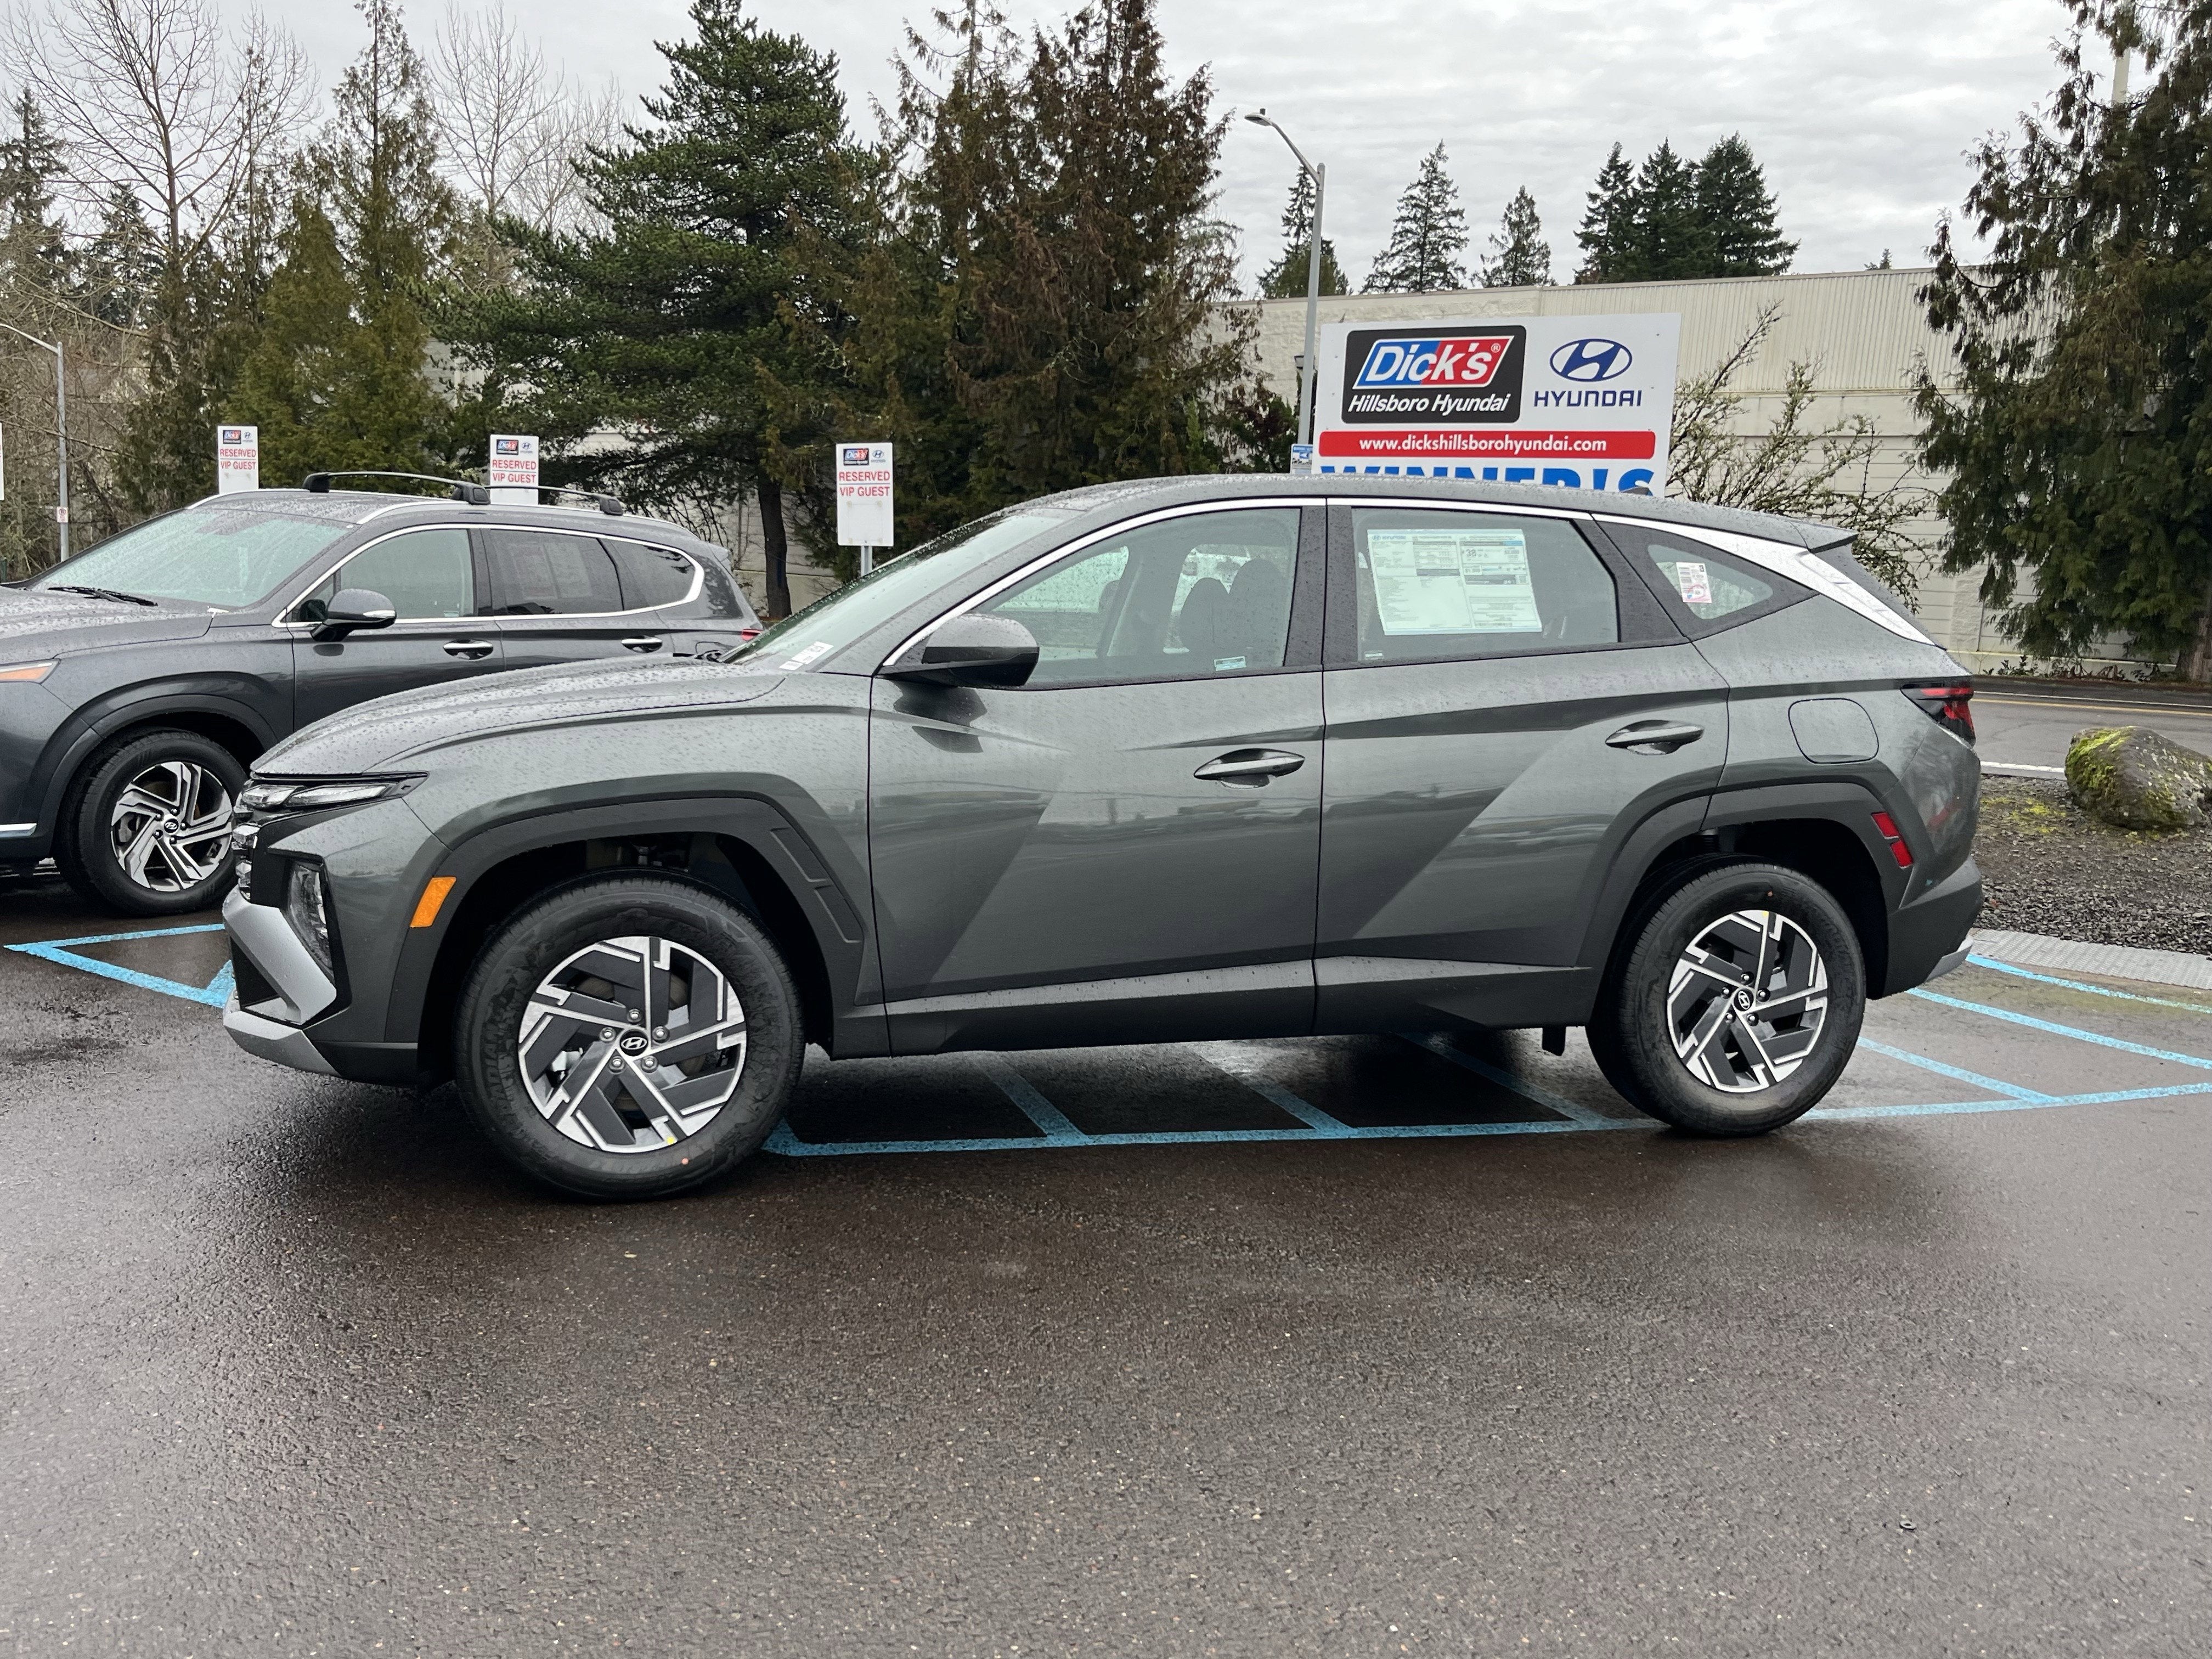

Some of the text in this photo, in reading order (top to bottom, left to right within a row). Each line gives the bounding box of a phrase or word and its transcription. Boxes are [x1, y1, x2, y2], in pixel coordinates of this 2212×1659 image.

[1533, 390, 1642, 407] HYUNDAI
[1347, 393, 1511, 416] Hillsboro Hyundai
[1359, 435, 1606, 455] www.dickshillsborohyundai.com
[219, 449, 256, 458] RESERVED
[233, 461, 256, 470] GUEST
[492, 459, 537, 470] RESERVED
[493, 473, 536, 483] VIP GUEST
[839, 471, 890, 482] RESERVED
[839, 486, 890, 496] VIP GUEST
